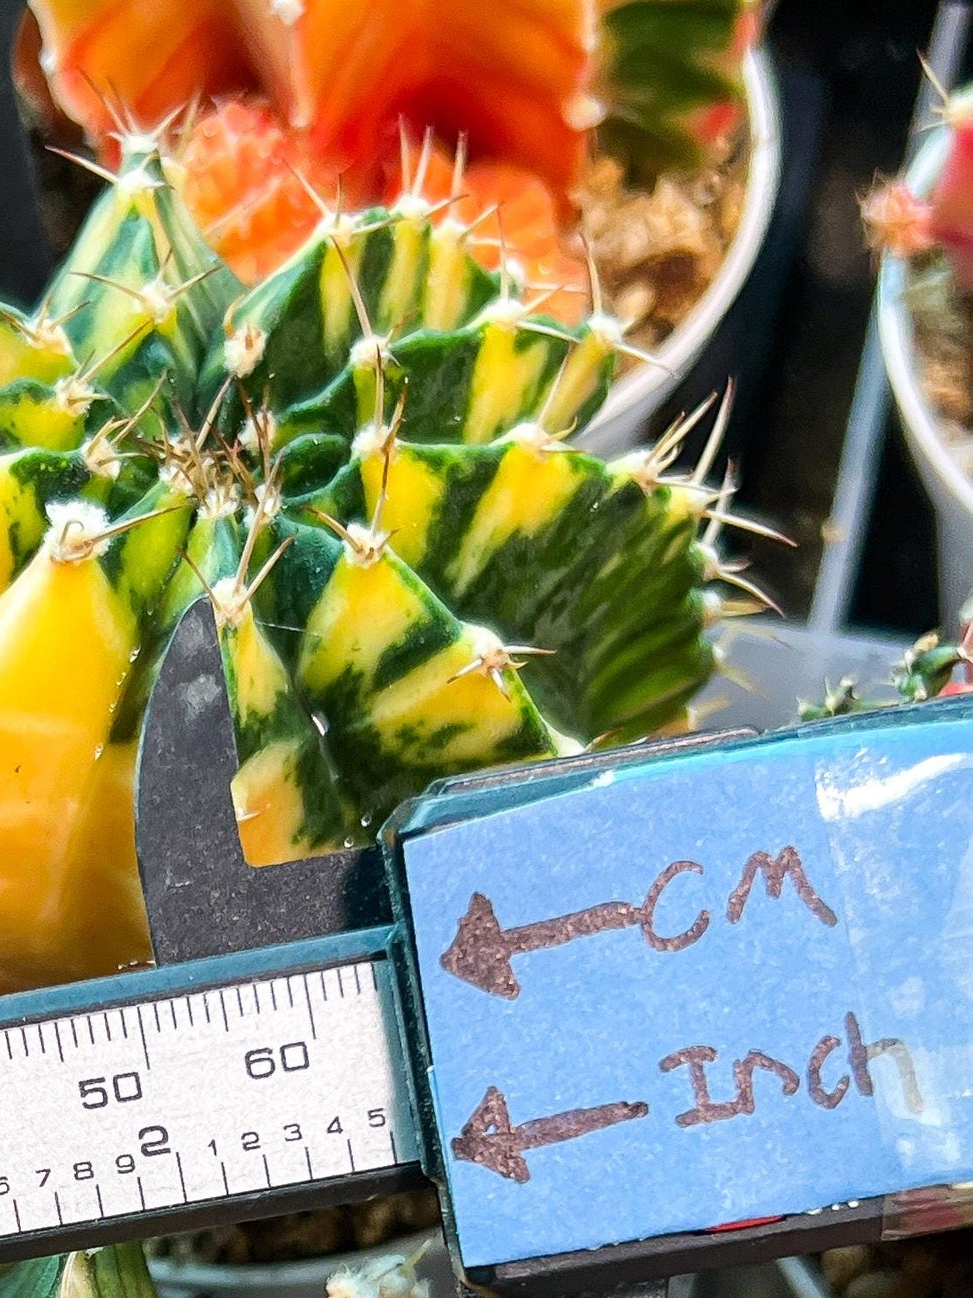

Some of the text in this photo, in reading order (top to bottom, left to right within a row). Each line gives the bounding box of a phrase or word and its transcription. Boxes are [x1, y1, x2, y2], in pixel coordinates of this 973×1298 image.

[640, 845, 839, 953] CM
[77, 1071, 143, 1110] 50
[244, 1041, 310, 1080] 60
[659, 1011, 924, 1129] Inch
[35, 1168, 52, 1187] 7
[73, 1161, 95, 1180] 8
[115, 1154, 136, 1174] 9
[138, 1125, 172, 1157] 2
[207, 1138, 218, 1157] 1
[240, 1131, 262, 1152] 2
[282, 1123, 303, 1142] 3
[326, 1116, 344, 1135] 4
[367, 1108, 386, 1128] 5
